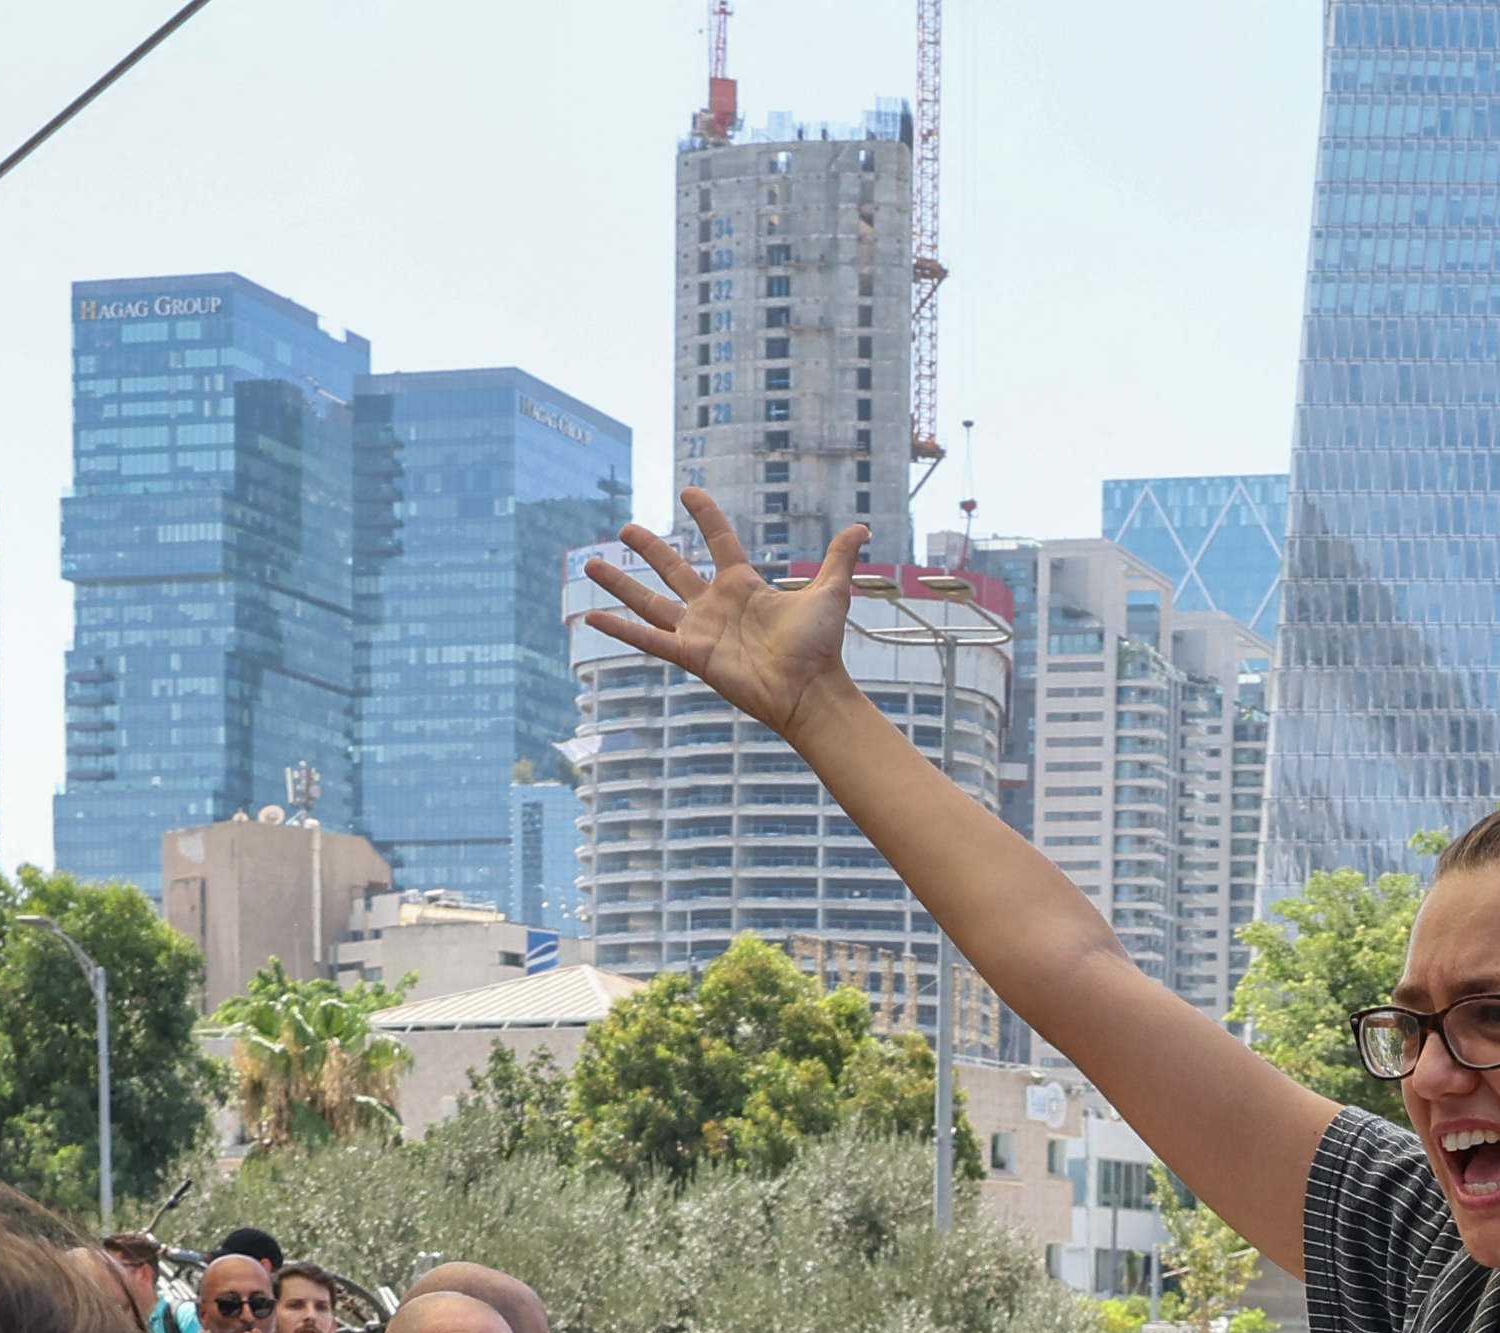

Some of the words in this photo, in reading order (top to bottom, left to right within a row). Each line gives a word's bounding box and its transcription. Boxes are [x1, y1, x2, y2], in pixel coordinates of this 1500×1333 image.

[714, 279, 734, 300] 32
[80, 299, 149, 321] HAGAG
[153, 295, 222, 317] GROUP
[714, 310, 734, 331] 31
